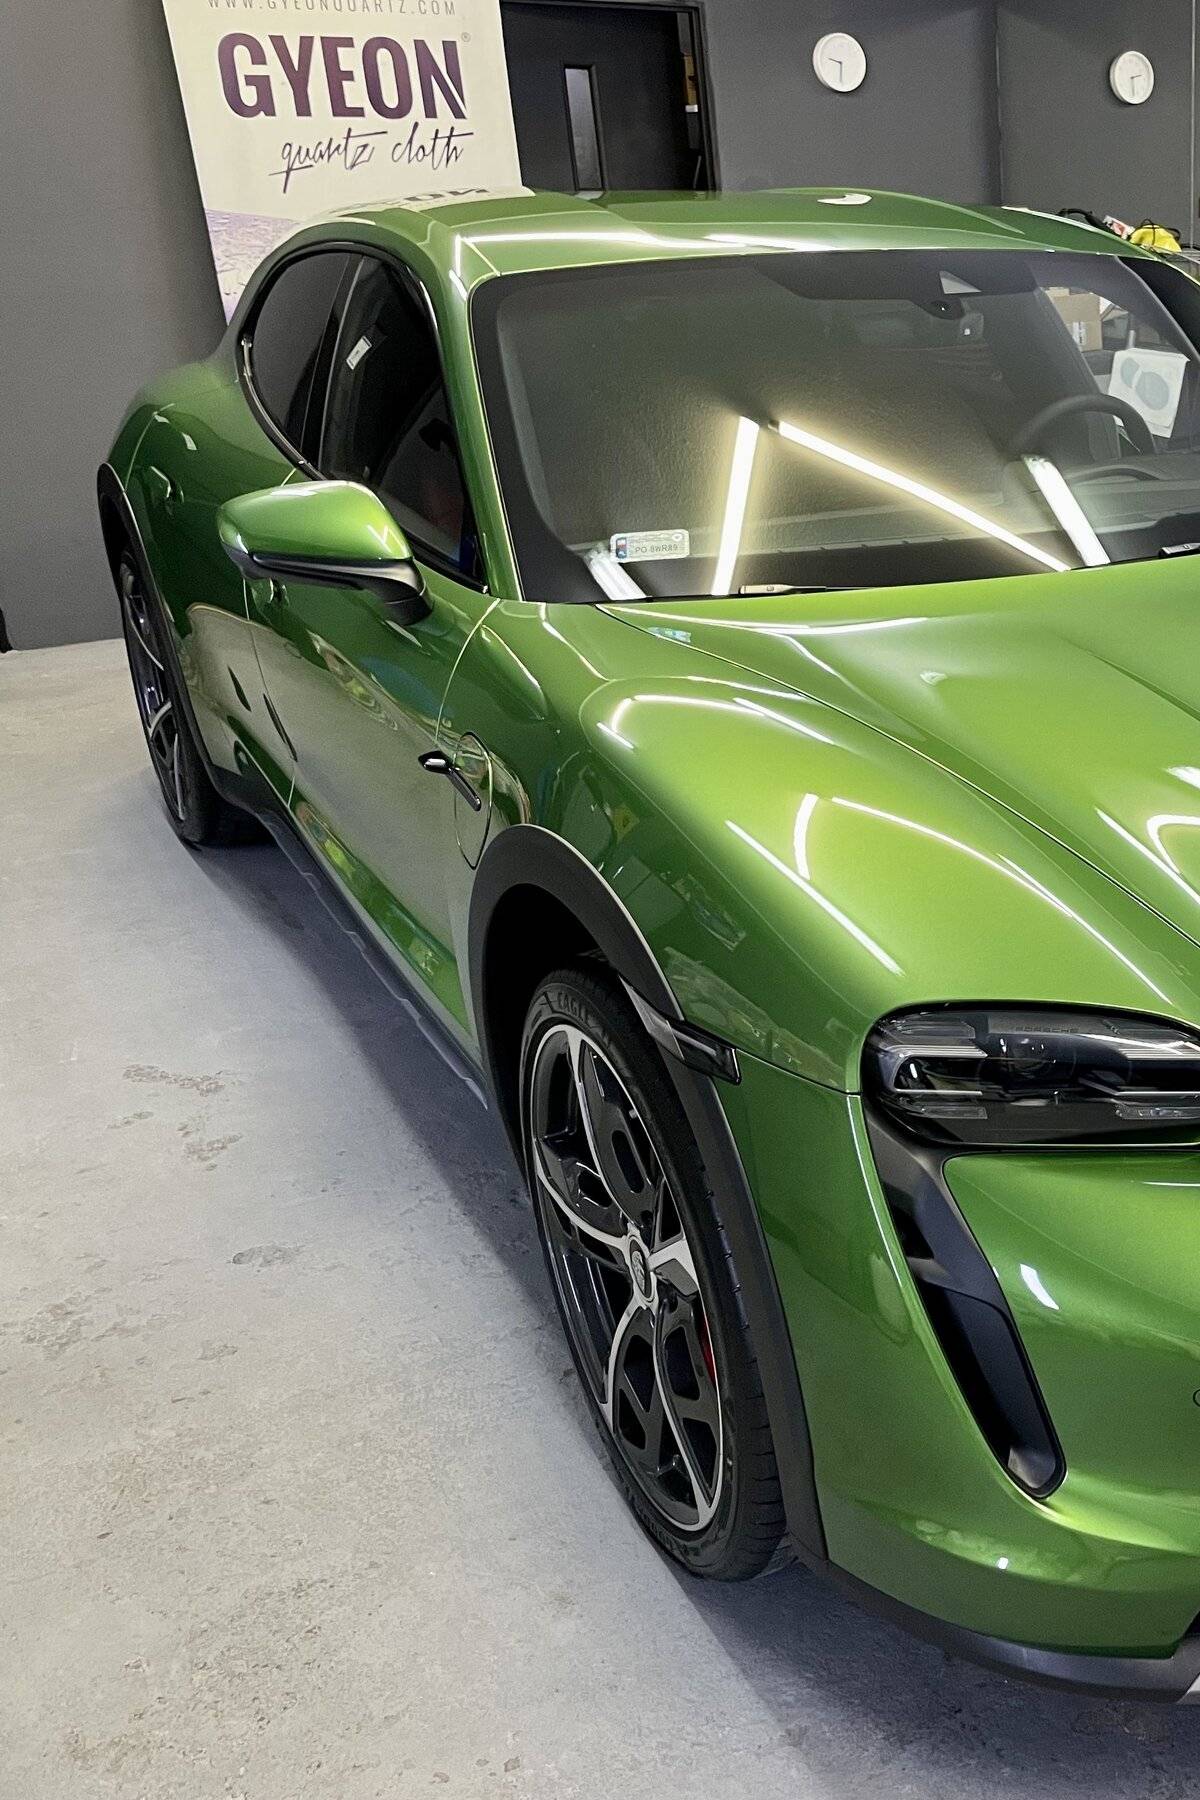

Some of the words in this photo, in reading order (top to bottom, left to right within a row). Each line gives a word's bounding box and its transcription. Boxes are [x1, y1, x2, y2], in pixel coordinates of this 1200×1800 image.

[217, 32, 468, 120] GYEON
[268, 126, 388, 194] quartz
[391, 121, 474, 170] cloth
